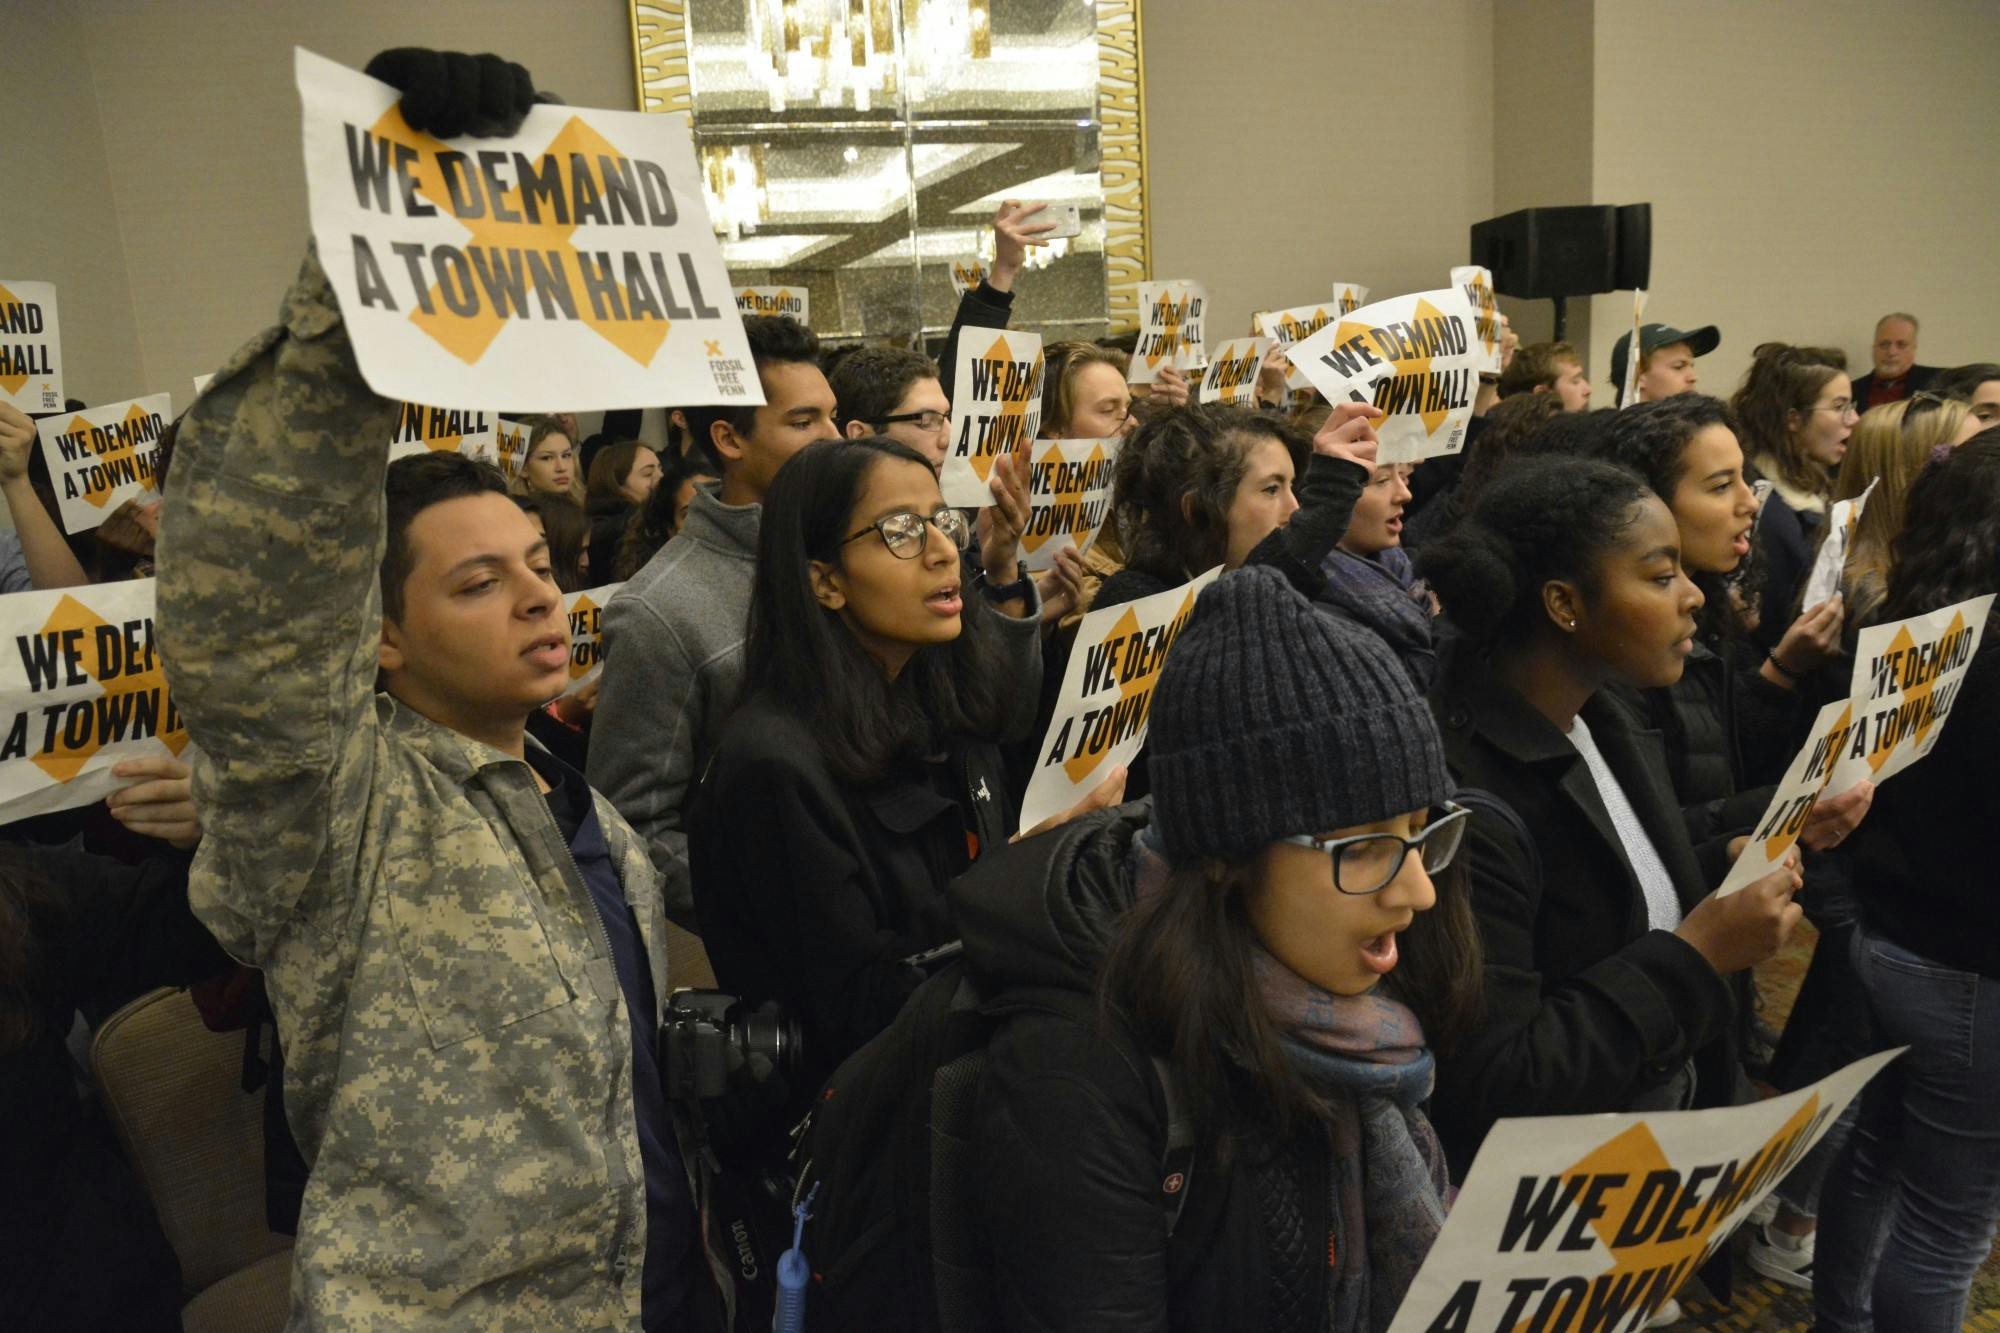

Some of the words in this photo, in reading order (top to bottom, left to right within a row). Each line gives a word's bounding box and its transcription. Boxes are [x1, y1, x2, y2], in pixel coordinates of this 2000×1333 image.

[343, 122, 438, 218] WE
[435, 150, 678, 228] DEMAND
[351, 233, 399, 312] A
[391, 241, 581, 320] TOWN
[576, 251, 721, 320] HALL
[0, 303, 43, 334] AND
[755, 296, 802, 313] DEMAND
[1139, 334, 1149, 356] A
[1272, 322, 1294, 343] WE
[1320, 335, 1382, 378] WE
[1369, 316, 1468, 362] DEMAND
[0, 345, 53, 375] HALL
[709, 360, 745, 371] FOSSIL
[713, 372, 740, 384] FREE
[971, 358, 1003, 401] WE
[1207, 360, 1227, 391] WE
[1220, 356, 1259, 388] DEMAND
[718, 384, 746, 396] PENN
[1426, 368, 1469, 413] HALL
[55, 430, 91, 462] WE
[90, 413, 163, 455] DEMAND
[429, 406, 488, 439] HALL
[955, 415, 971, 456] A
[976, 415, 1020, 456] TOWN
[64, 472, 79, 499] A
[77, 457, 136, 494] TOWN
[1030, 462, 1055, 495] WE
[1055, 458, 1112, 494] DEMAND
[1026, 503, 1077, 537] TOWN
[1076, 499, 1106, 533] HALL
[16, 629, 88, 693] WE
[1081, 636, 1125, 698] WE
[1870, 650, 1904, 700] WE
[1903, 626, 1973, 690] DEMAND
[1, 711, 28, 761] A
[42, 687, 160, 754] TOWN
[1045, 716, 1075, 767] A
[1073, 689, 1149, 760] TOWN
[1850, 716, 1868, 760] A
[1873, 695, 1927, 754] TOWN
[1801, 730, 1841, 784] WE
[1755, 800, 1791, 842] A
[1498, 1173, 1629, 1252] WE
[731, 1219, 758, 1280] Canon
[1424, 1280, 1481, 1333] A
[1495, 1255, 1692, 1333] TOWN
